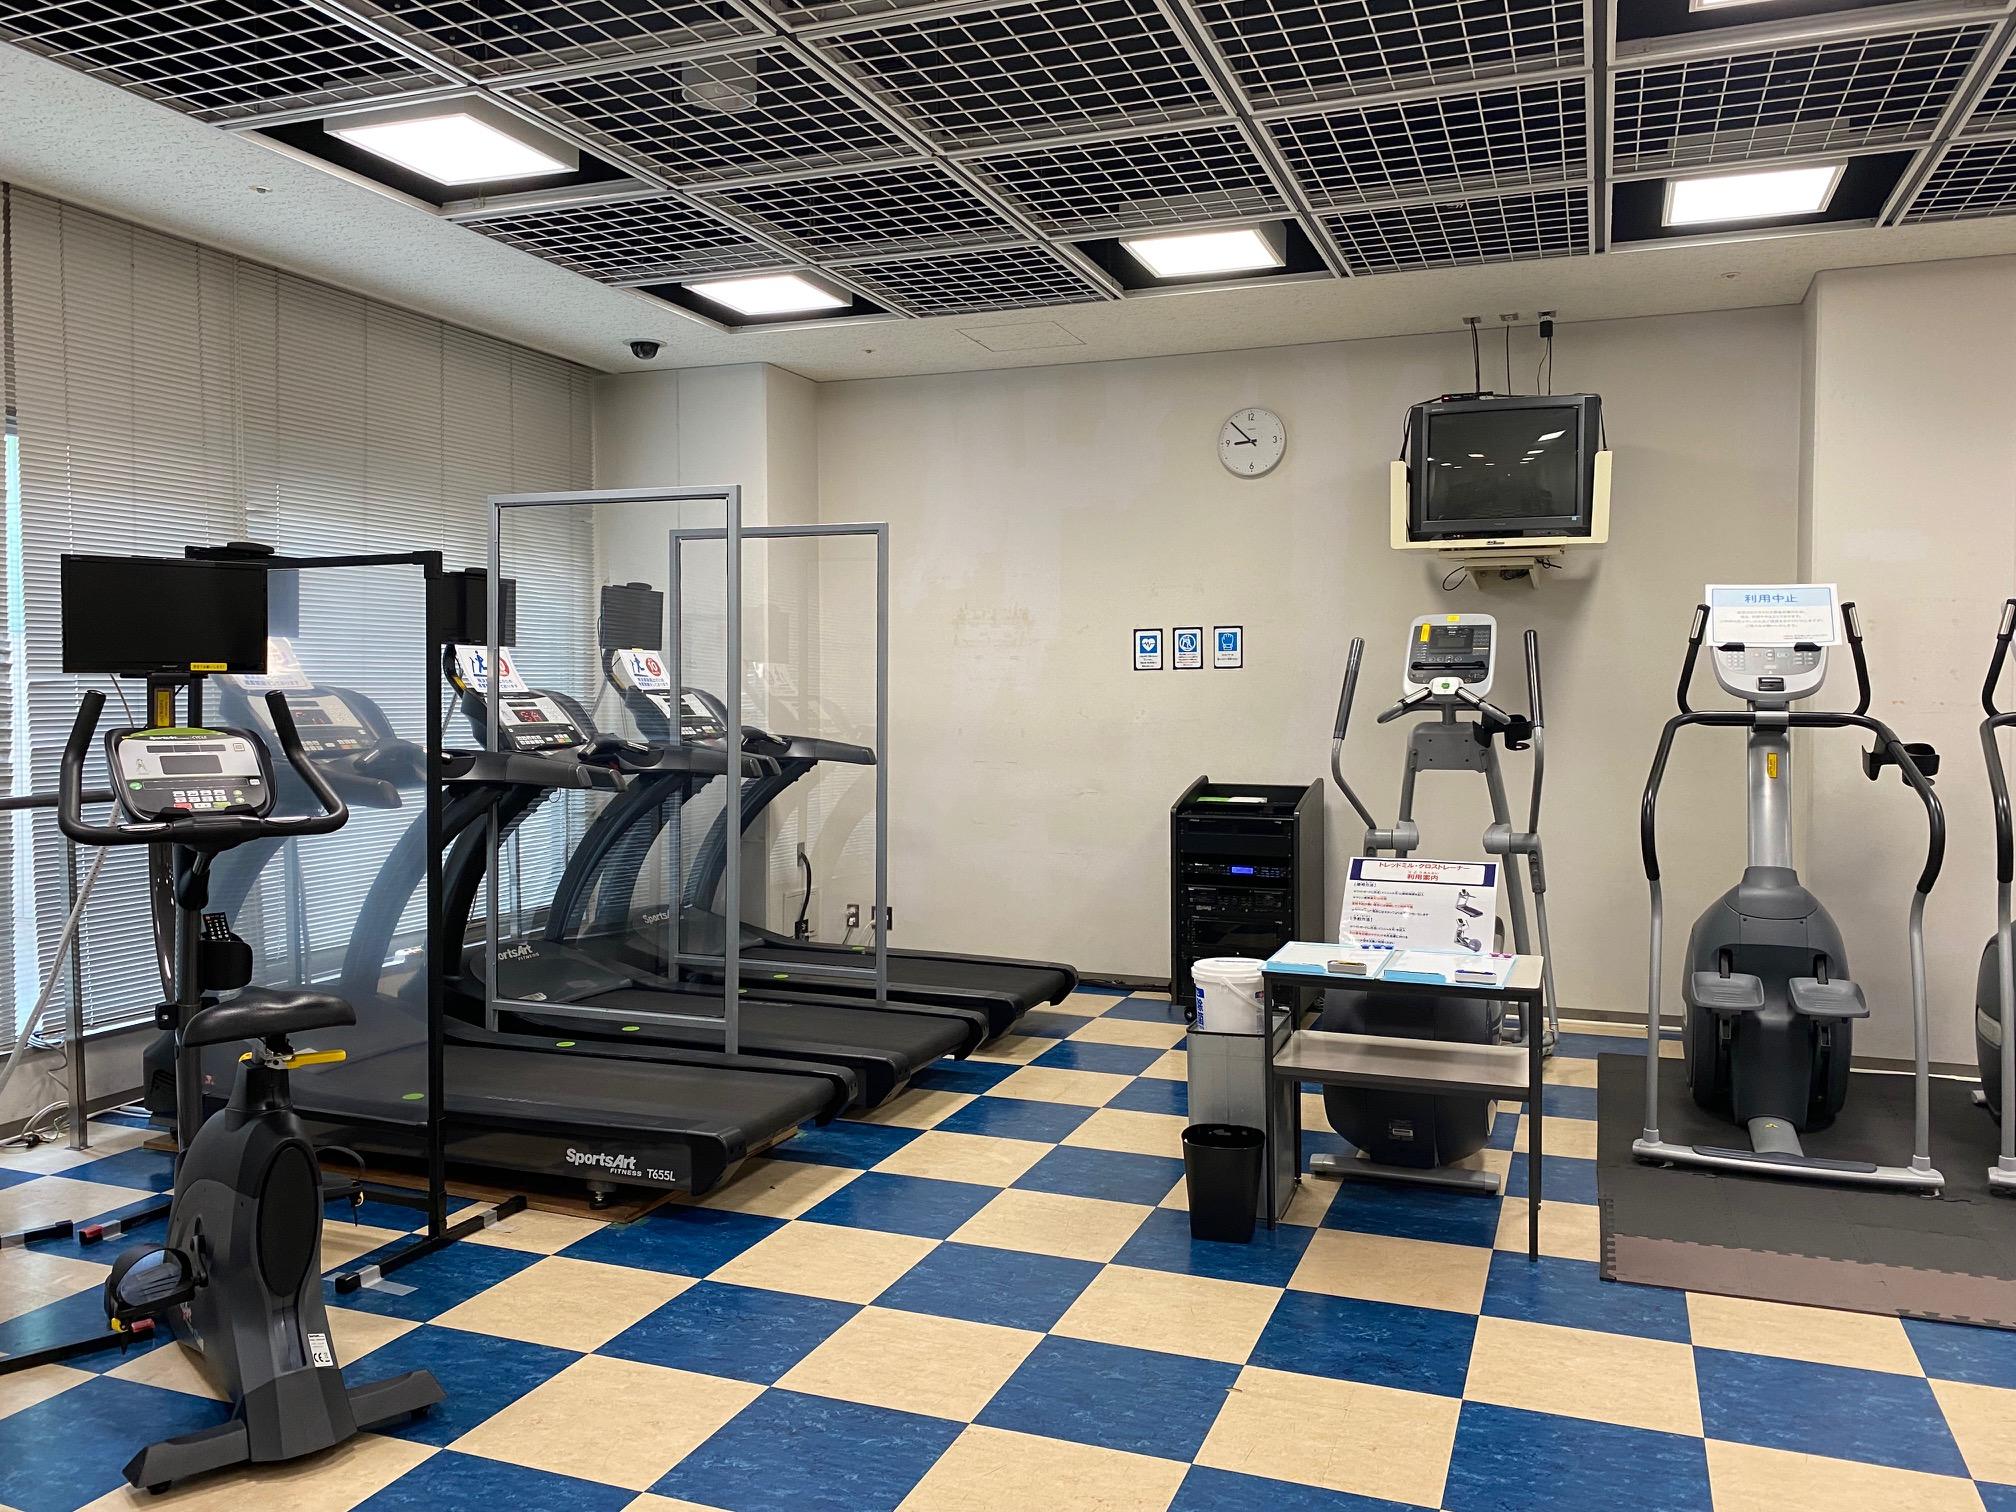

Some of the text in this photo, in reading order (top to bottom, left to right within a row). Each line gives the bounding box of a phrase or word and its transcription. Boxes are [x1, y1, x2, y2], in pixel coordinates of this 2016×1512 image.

[1247, 413, 1255, 421] 12
[1272, 435, 1278, 443] 3
[1249, 462, 1255, 470] 6
[1744, 594, 1799, 604] 利用中止
[1379, 862, 1471, 871] トレッドミル・クロストレーナー
[1407, 873, 1439, 881] 利用案内
[565, 1147, 637, 1170] SportsArt
[609, 1168, 642, 1177] FITNESS
[647, 1168, 676, 1182] T655L
